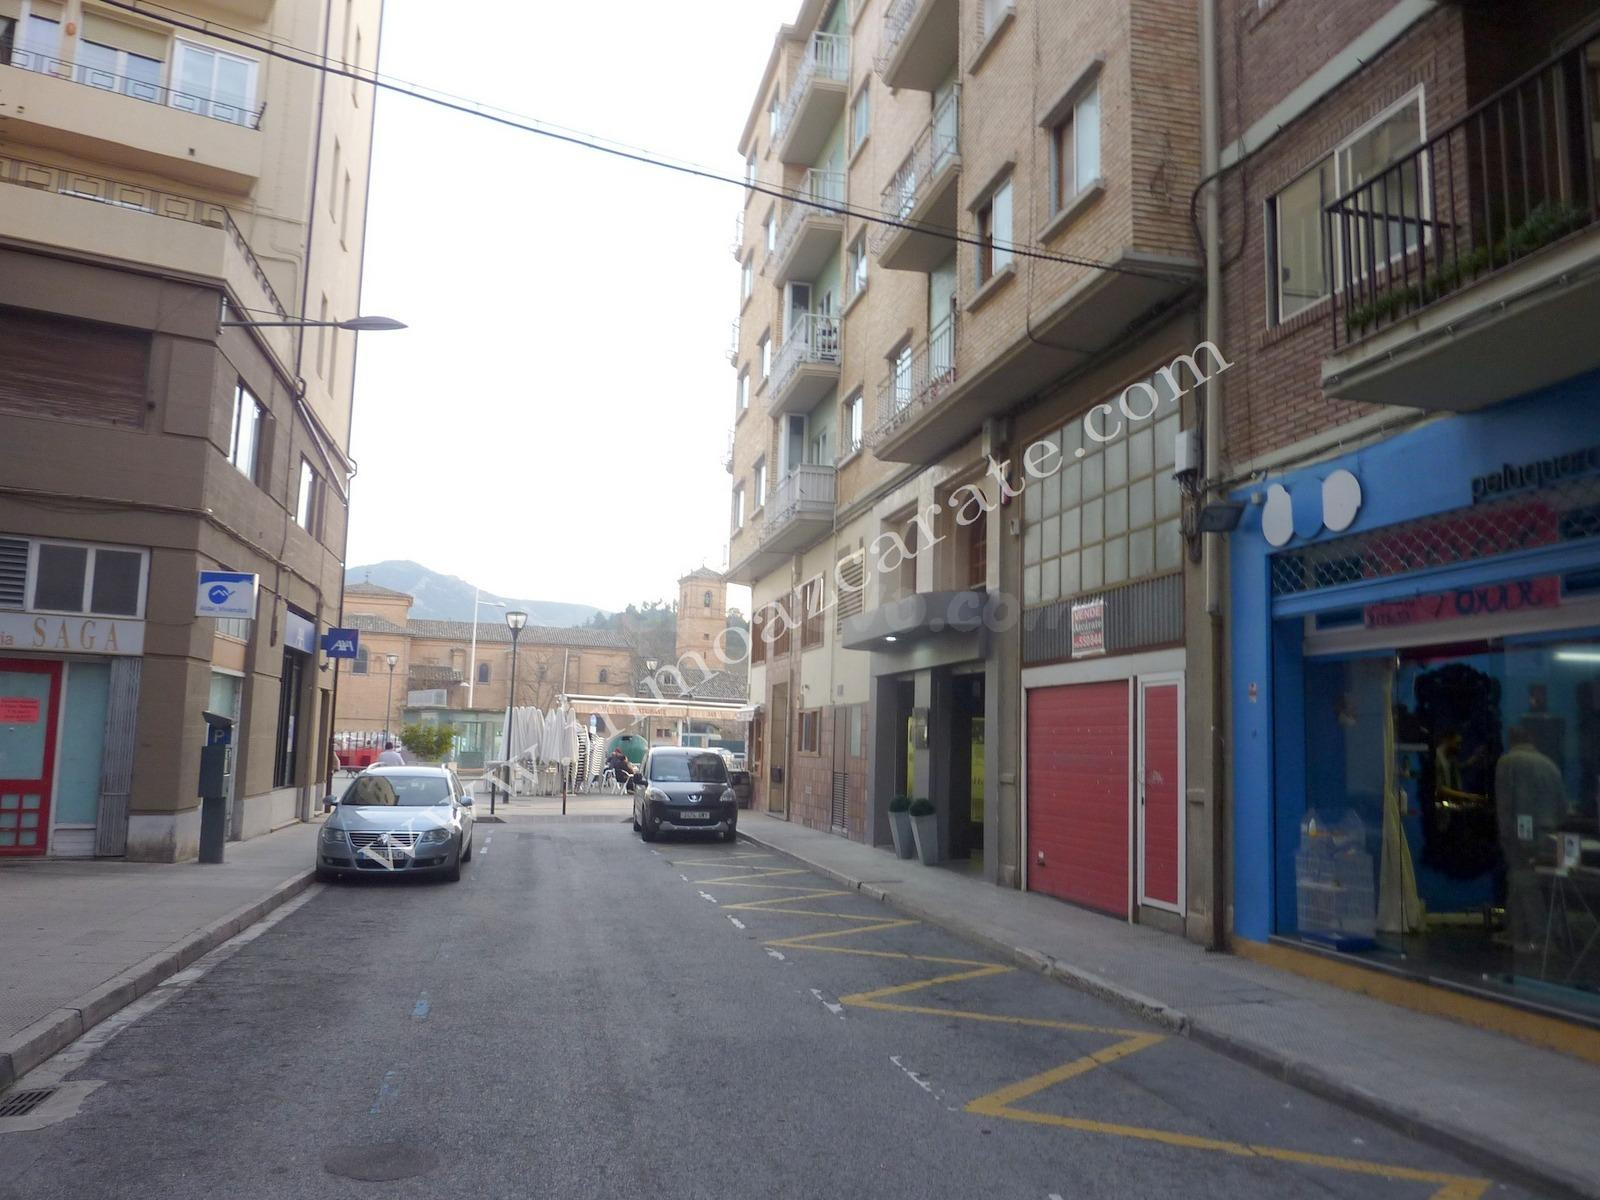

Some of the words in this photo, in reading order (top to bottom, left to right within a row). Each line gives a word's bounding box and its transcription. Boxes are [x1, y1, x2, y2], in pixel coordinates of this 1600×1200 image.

[32, 616, 119, 651] SAGA
[330, 639, 355, 652] AXA
[214, 729, 226, 744] P
